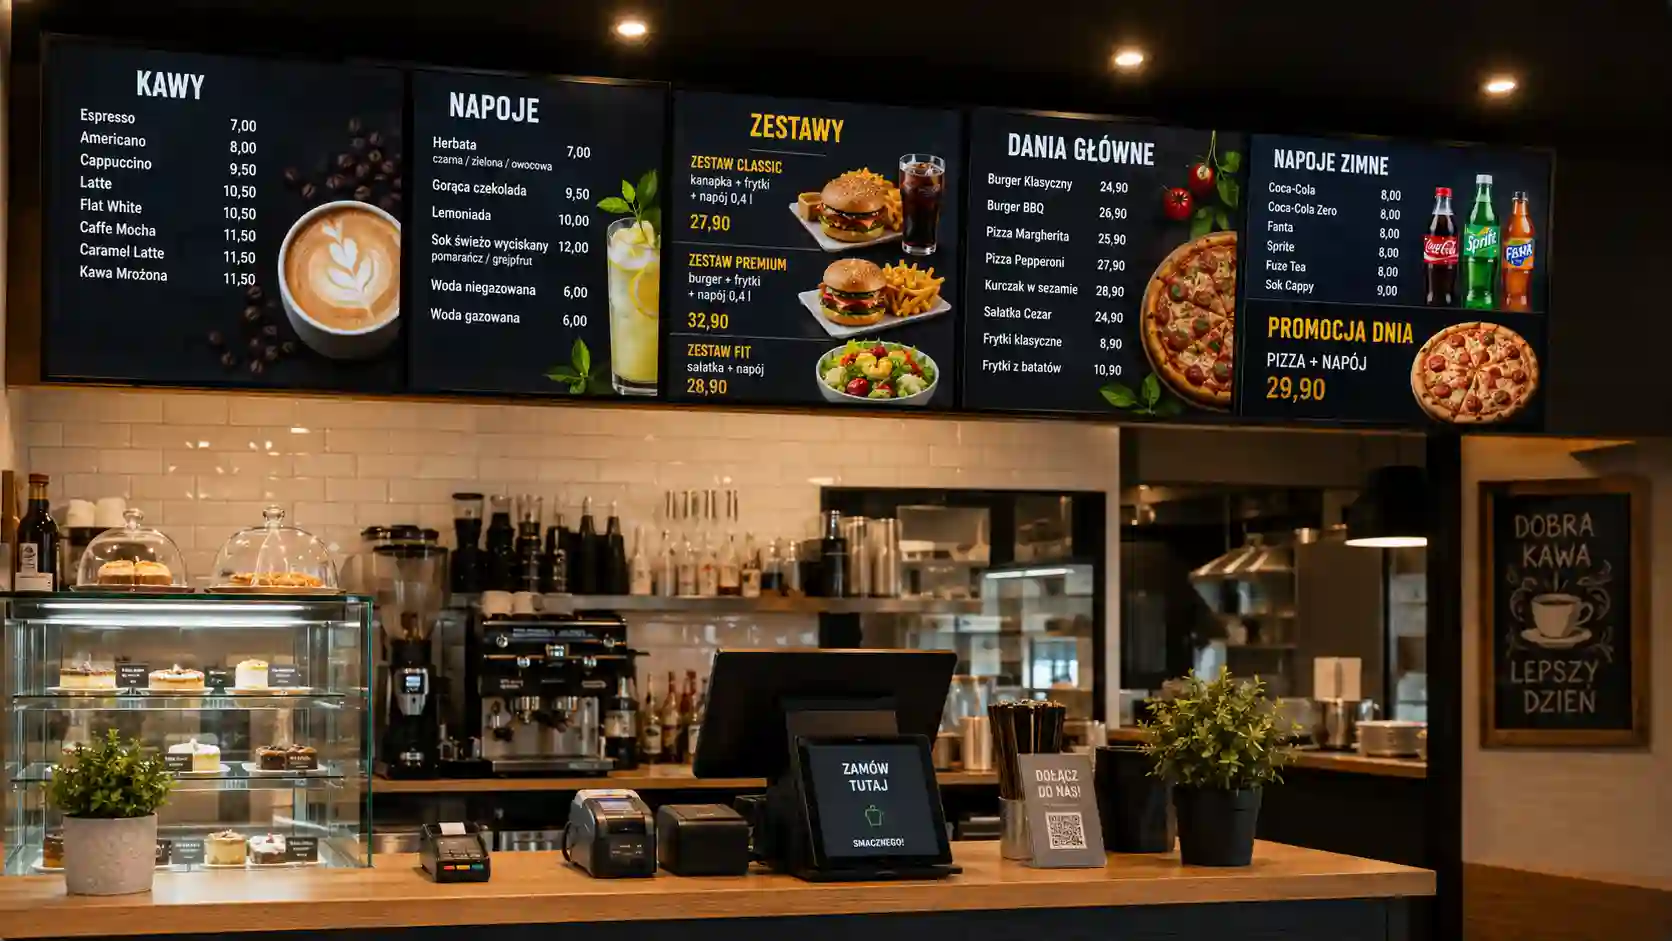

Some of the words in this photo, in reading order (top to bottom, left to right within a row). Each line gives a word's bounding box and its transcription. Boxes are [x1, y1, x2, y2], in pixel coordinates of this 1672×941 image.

[137, 70, 204, 99] KAWY
[450, 92, 539, 123] NAPOJE
[81, 109, 135, 124] Espresso
[231, 119, 256, 133] 7,00
[750, 113, 843, 142] ZESTAWY
[80, 131, 145, 147] Americano
[230, 141, 256, 155] 8,00
[433, 136, 476, 150] Herbata
[567, 146, 590, 159] 7,00
[1008, 133, 1066, 159] DANIA
[1074, 135, 1154, 165] GŁÓWNE
[81, 154, 151, 169] Cappuccino
[230, 163, 256, 176] 9,50
[465, 156, 470, 166] /
[472, 156, 503, 167] zielona
[505, 158, 509, 168] /
[512, 161, 552, 171] owocowa
[691, 156, 733, 170] ZESTAW
[737, 159, 782, 173] CLASSIC
[1274, 149, 1335, 172] NAPOJE
[1341, 154, 1388, 175] ZIMNE
[81, 176, 112, 189] Latte
[224, 185, 256, 199] 10,50
[433, 179, 470, 194] Gorąca
[474, 182, 526, 196] czekolada
[566, 188, 589, 201] 9,50
[691, 174, 732, 189] kanapka
[745, 177, 769, 191] frytki
[988, 173, 1021, 187] Burger
[1100, 181, 1128, 194] 24,90
[1269, 182, 1315, 195] Coca-Cola
[1381, 190, 1401, 201] 8,00
[700, 192, 727, 205] napój
[731, 193, 746, 205] 0,4
[81, 198, 104, 211] Flat
[107, 200, 142, 213] White
[224, 207, 256, 221] 10,50
[433, 206, 491, 220] Lemoniada
[559, 214, 589, 227] 10,00
[988, 200, 1020, 214] Burger
[1024, 202, 1044, 214] BBQ
[1100, 207, 1127, 220] 26,90
[1269, 201, 1314, 214] Coca-Cola
[1317, 205, 1337, 215] Zero
[1380, 209, 1400, 220] 8,00
[80, 221, 112, 234] Caffe
[117, 223, 155, 236] Mocha
[224, 229, 256, 243] 11,50
[691, 214, 730, 231] 27,90
[1268, 221, 1293, 232] Fanta
[1380, 228, 1399, 239] 8,00
[432, 234, 452, 245] Sok
[455, 235, 491, 248] świeżo
[494, 238, 548, 253] wyciskany
[559, 241, 588, 254] 12,00
[987, 226, 1012, 238] Pizza
[1016, 228, 1069, 242] Margherita
[1099, 233, 1126, 246] 25,90
[80, 243, 129, 257] Caramel
[134, 246, 164, 259] Latte
[224, 251, 255, 265] 11,50
[1267, 240, 1294, 253] Sprite
[1379, 247, 1398, 258] 8,00
[432, 252, 483, 263] pomarańcz
[485, 253, 490, 264] /
[493, 254, 532, 267] grejpfrut
[689, 254, 732, 268] ZESTAW
[736, 256, 786, 270] PREMIUM
[986, 252, 1011, 264] Pizza
[1015, 255, 1064, 268] Pepperoni
[1098, 259, 1125, 272] 27,90
[1266, 260, 1287, 271] Fuze
[1290, 261, 1306, 272] Tea
[1378, 267, 1398, 278] 8,00
[80, 265, 112, 278] Kawa
[117, 267, 167, 281] Mrożona
[224, 273, 255, 286] 11,50
[689, 272, 722, 286] burger
[735, 274, 760, 288] frytki
[431, 279, 461, 291] Woda
[466, 281, 535, 296] niegazowana
[564, 286, 587, 299] 6,00
[698, 290, 725, 303] napój
[729, 291, 745, 303] 0,4
[985, 280, 1024, 291] Kurczak
[1028, 284, 1035, 292] w
[1038, 284, 1077, 294] sezamie
[1096, 285, 1124, 298] 28,90
[1266, 279, 1282, 290] Sok
[1286, 280, 1314, 293] Cappy
[1377, 285, 1397, 296] 9,00
[431, 308, 461, 320] Woda
[465, 312, 520, 324] gazowana
[563, 315, 587, 327] 6,00
[688, 312, 728, 330] 32,90
[1024, 308, 1052, 319] Cezar
[1095, 311, 1123, 324] 24,90
[1268, 317, 1366, 342] PROMOCJA
[1373, 322, 1413, 343] DNIA
[688, 344, 730, 357] ZESTAW
[735, 346, 751, 358] FIT
[984, 333, 1011, 346] Frytki
[1015, 334, 1062, 348] klasyczne
[1100, 338, 1122, 350] 8,90
[736, 364, 764, 377] napój
[983, 360, 1010, 373] Frytki
[1013, 363, 1018, 371] z
[1022, 361, 1061, 373] batatów
[1095, 364, 1122, 376] 10,90
[1267, 353, 1305, 368] PIZZA
[1310, 357, 1318, 366] +
[1323, 352, 1366, 370] NAPÓJ
[687, 378, 727, 396] 28,90
[1267, 376, 1325, 403] 29,90
[1515, 512, 1594, 538] DOBRA
[1523, 544, 1590, 567] KAWA
[1511, 660, 1598, 683] LEPSZY
[842, 760, 888, 774] ZAMÓW
[1036, 770, 1078, 783] DOŁĄCZ
[849, 779, 888, 791] TUTAJ
[1038, 786, 1053, 798] DO
[853, 838, 904, 847] SMACZNEGO!
